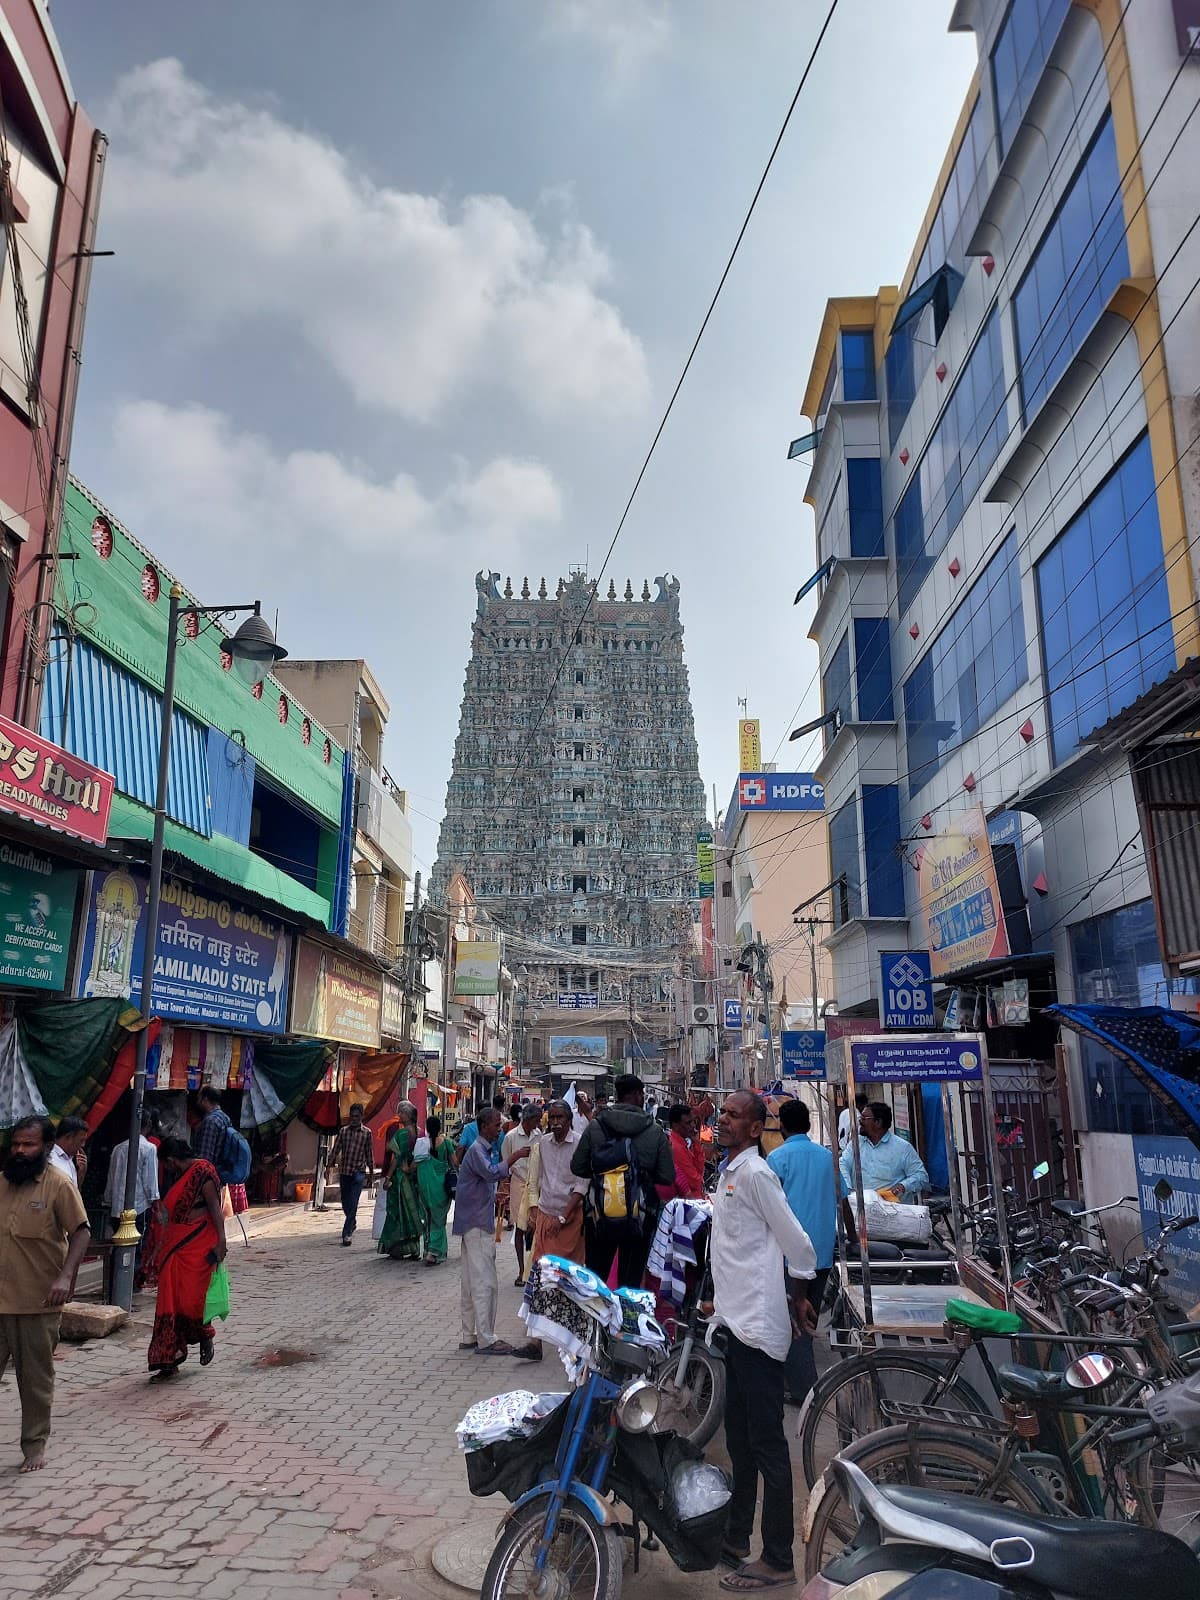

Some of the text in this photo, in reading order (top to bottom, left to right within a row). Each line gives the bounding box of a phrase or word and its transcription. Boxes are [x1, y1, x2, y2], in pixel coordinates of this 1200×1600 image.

[41, 757, 100, 814] Hall
[772, 784, 825, 799] HDFC
[15, 923, 57, 940] WE ACCEPT ALL
[5, 934, 63, 953] DEBIT/CREDIT CARDS
[160, 920, 260, 967] तमिल नाडु स्टेट
[0, 962, 53, 981] adurai-625001
[153, 954, 267, 998] AMILNADU STATE
[889, 989, 928, 1010] IOB
[887, 1014, 934, 1025] ATM / CDM
[785, 1049, 802, 1058] Indian
[1142, 1184, 1167, 1214] HOTL
